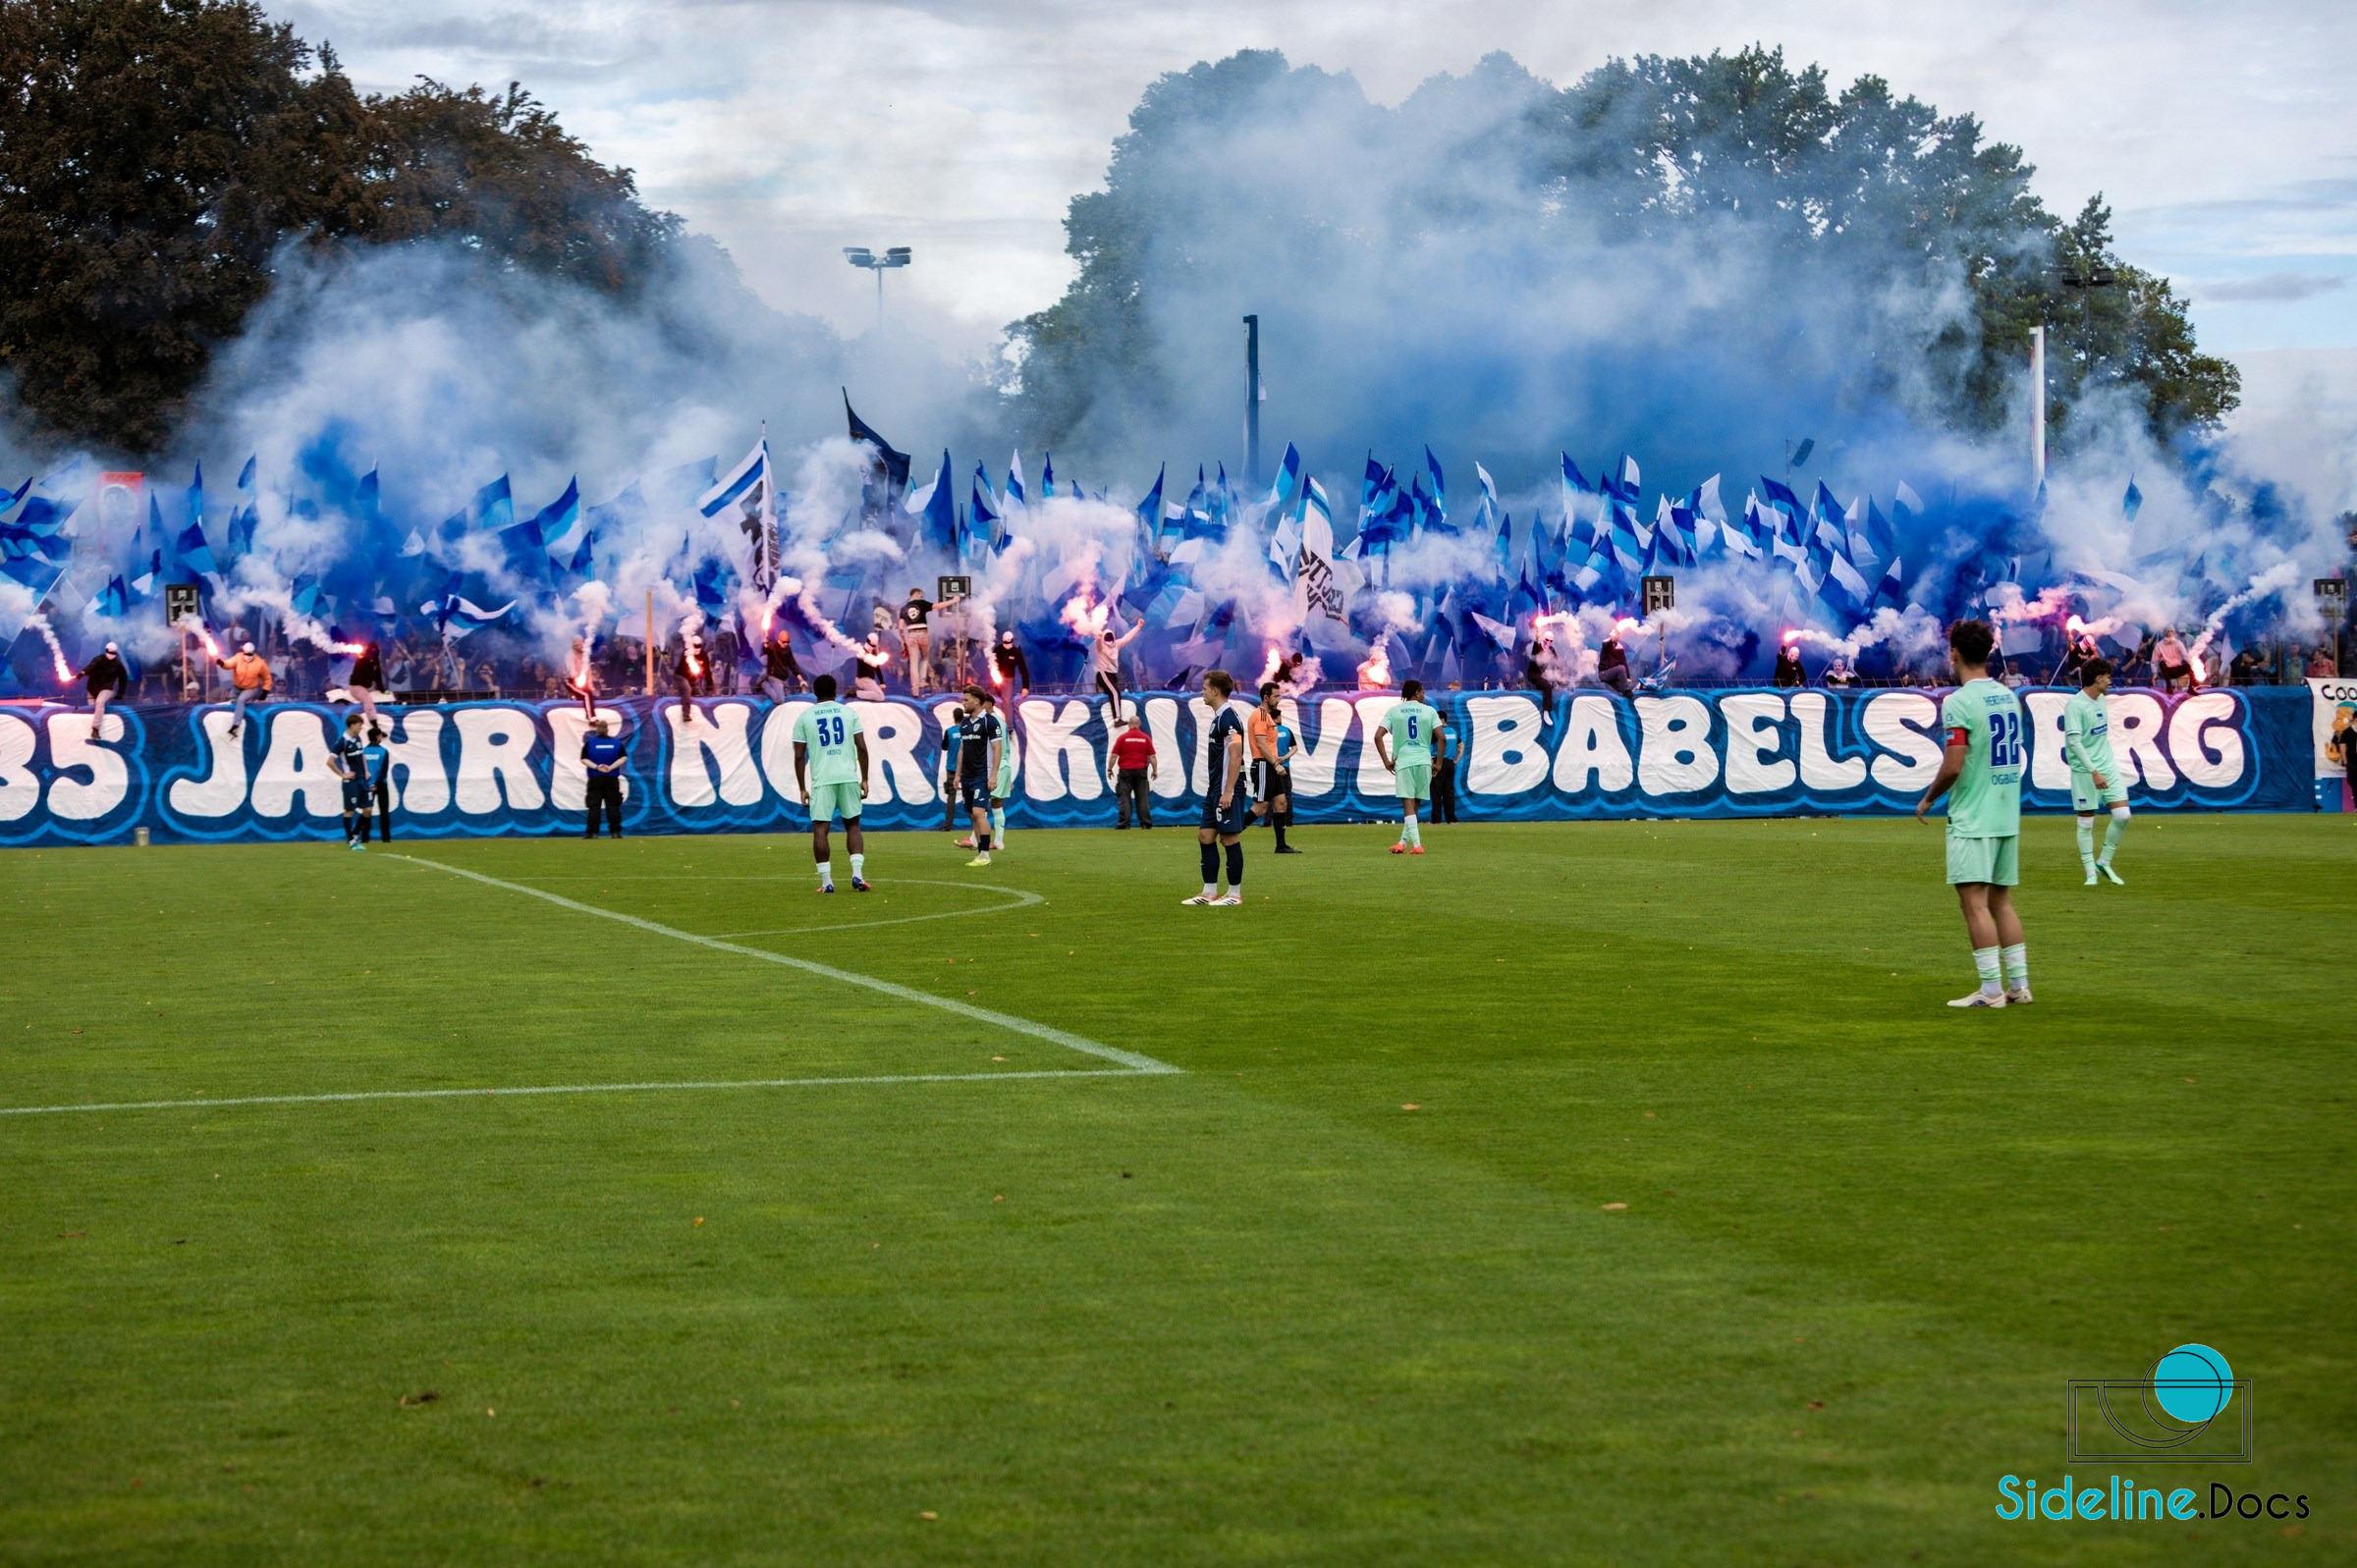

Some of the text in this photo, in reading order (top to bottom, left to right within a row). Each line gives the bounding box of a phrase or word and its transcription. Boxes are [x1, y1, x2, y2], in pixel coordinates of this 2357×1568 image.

[816, 716, 845, 747] 39
[1407, 715, 1418, 740] 6
[1988, 710, 2022, 768] 22
[169, 706, 630, 818] JAHRE
[1466, 692, 2244, 796] BABELSERG
[973, 788, 981, 800] 8
[1215, 807, 1223, 822] 6
